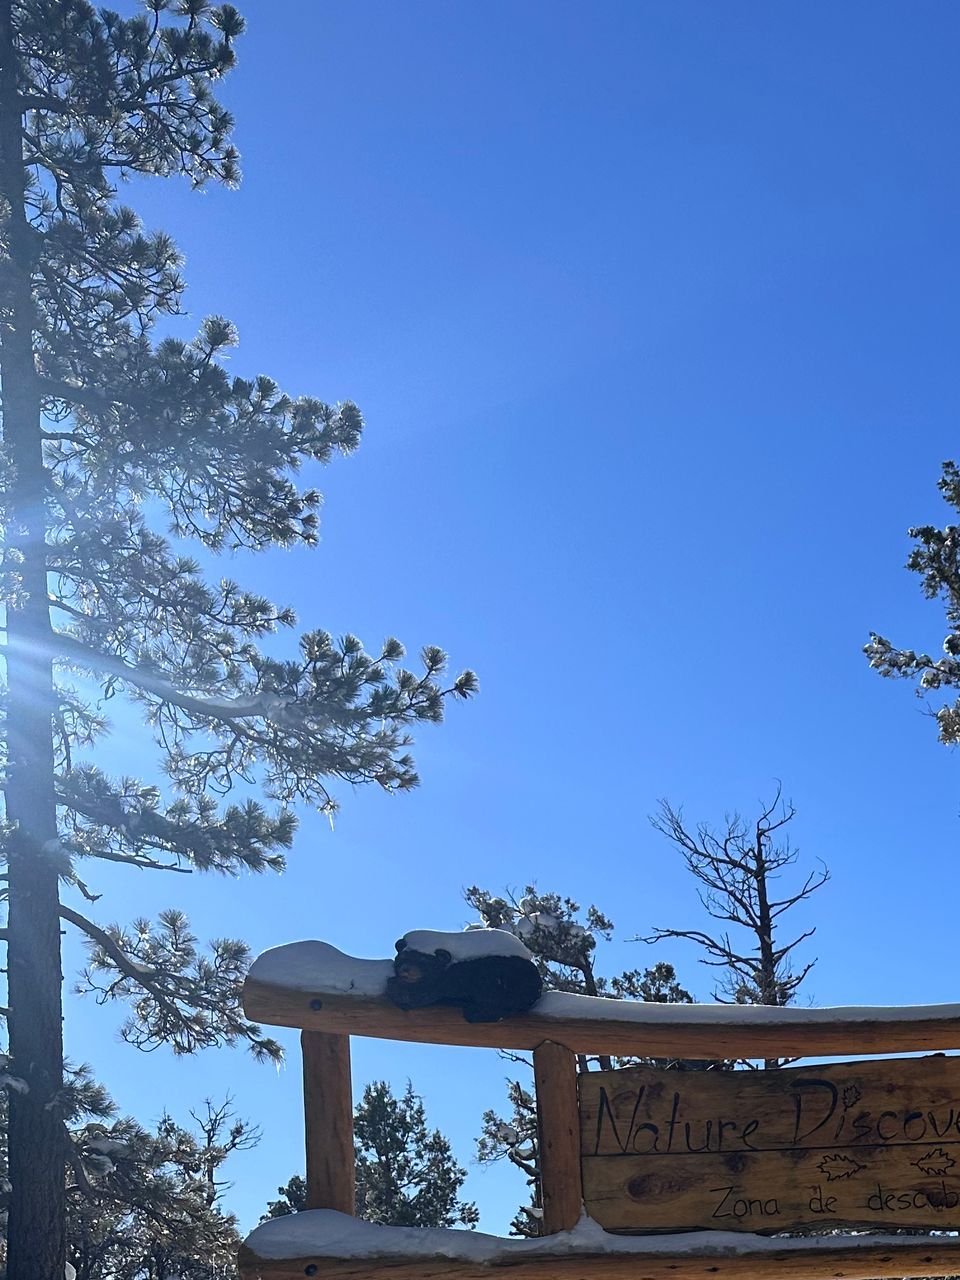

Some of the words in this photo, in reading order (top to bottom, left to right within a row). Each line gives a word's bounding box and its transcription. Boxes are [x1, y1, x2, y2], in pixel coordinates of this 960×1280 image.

[594, 1085, 760, 1155] Nature
[709, 1186, 781, 1218] Zona
[808, 1184, 838, 1214] de
